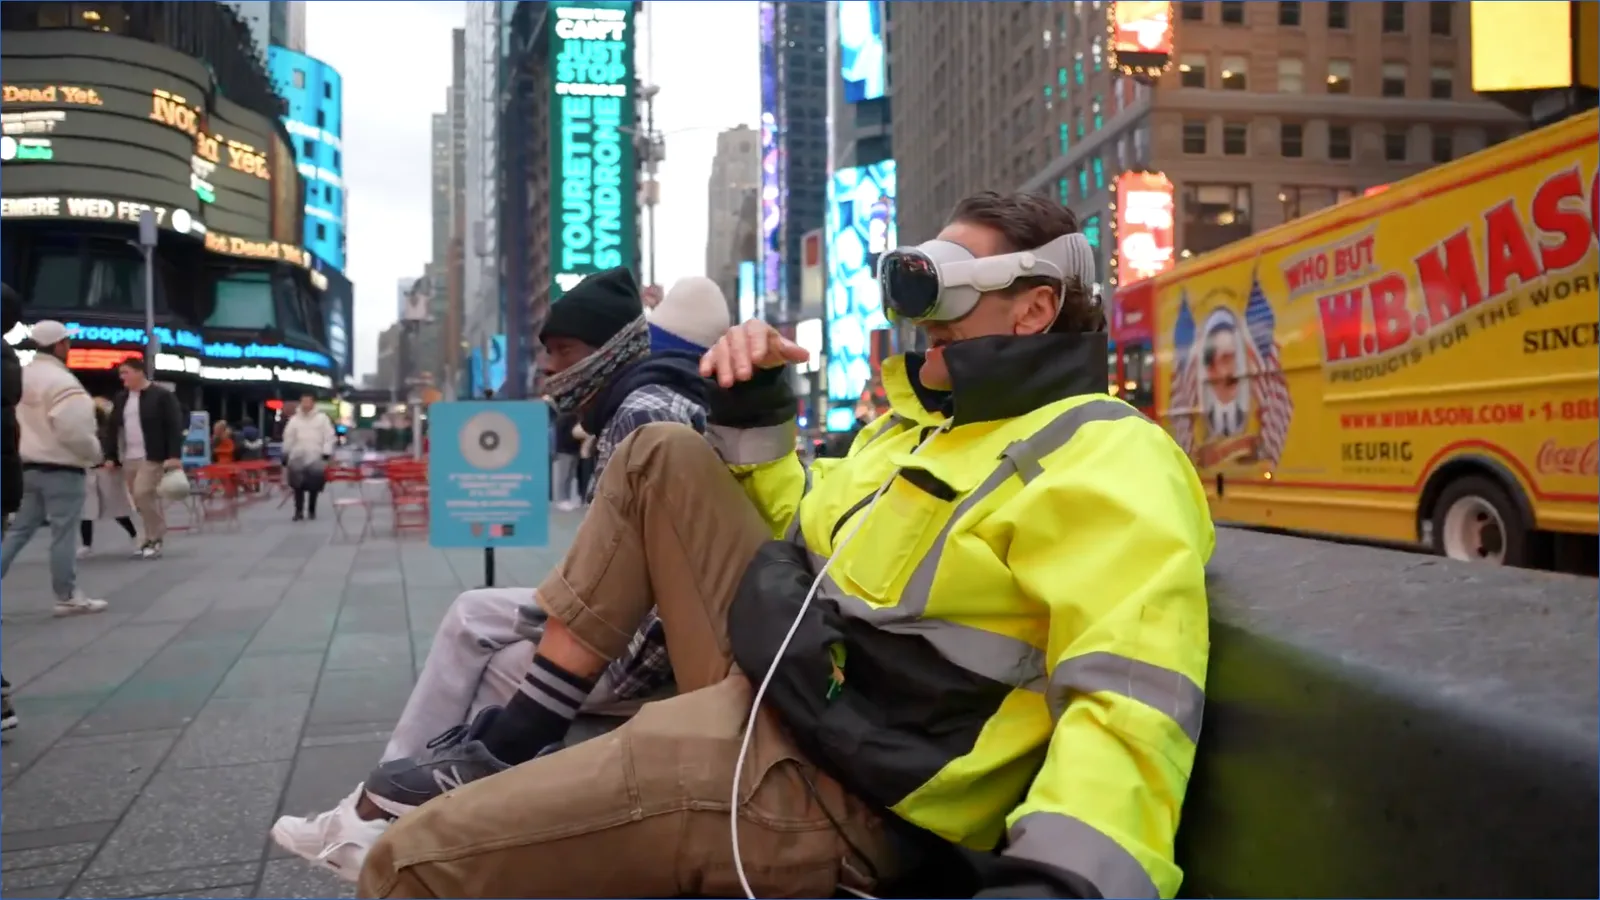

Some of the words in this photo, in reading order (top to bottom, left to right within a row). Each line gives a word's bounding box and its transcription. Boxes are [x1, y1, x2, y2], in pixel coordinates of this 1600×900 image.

[557, 40, 626, 62] JUST
[557, 62, 626, 84] STOP
[562, 96, 592, 270] TOURETTE
[593, 96, 621, 270] SYNDROME
[67, 197, 115, 218] WED
[154, 207, 166, 225] 7
[1286, 253, 1328, 293] WHO
[1335, 235, 1374, 276] BUT
[1330, 347, 1422, 383] PRODUCTS
[1429, 324, 1468, 353] FOR
[1476, 298, 1520, 330] THE
[1341, 441, 1412, 463] KEURIG
